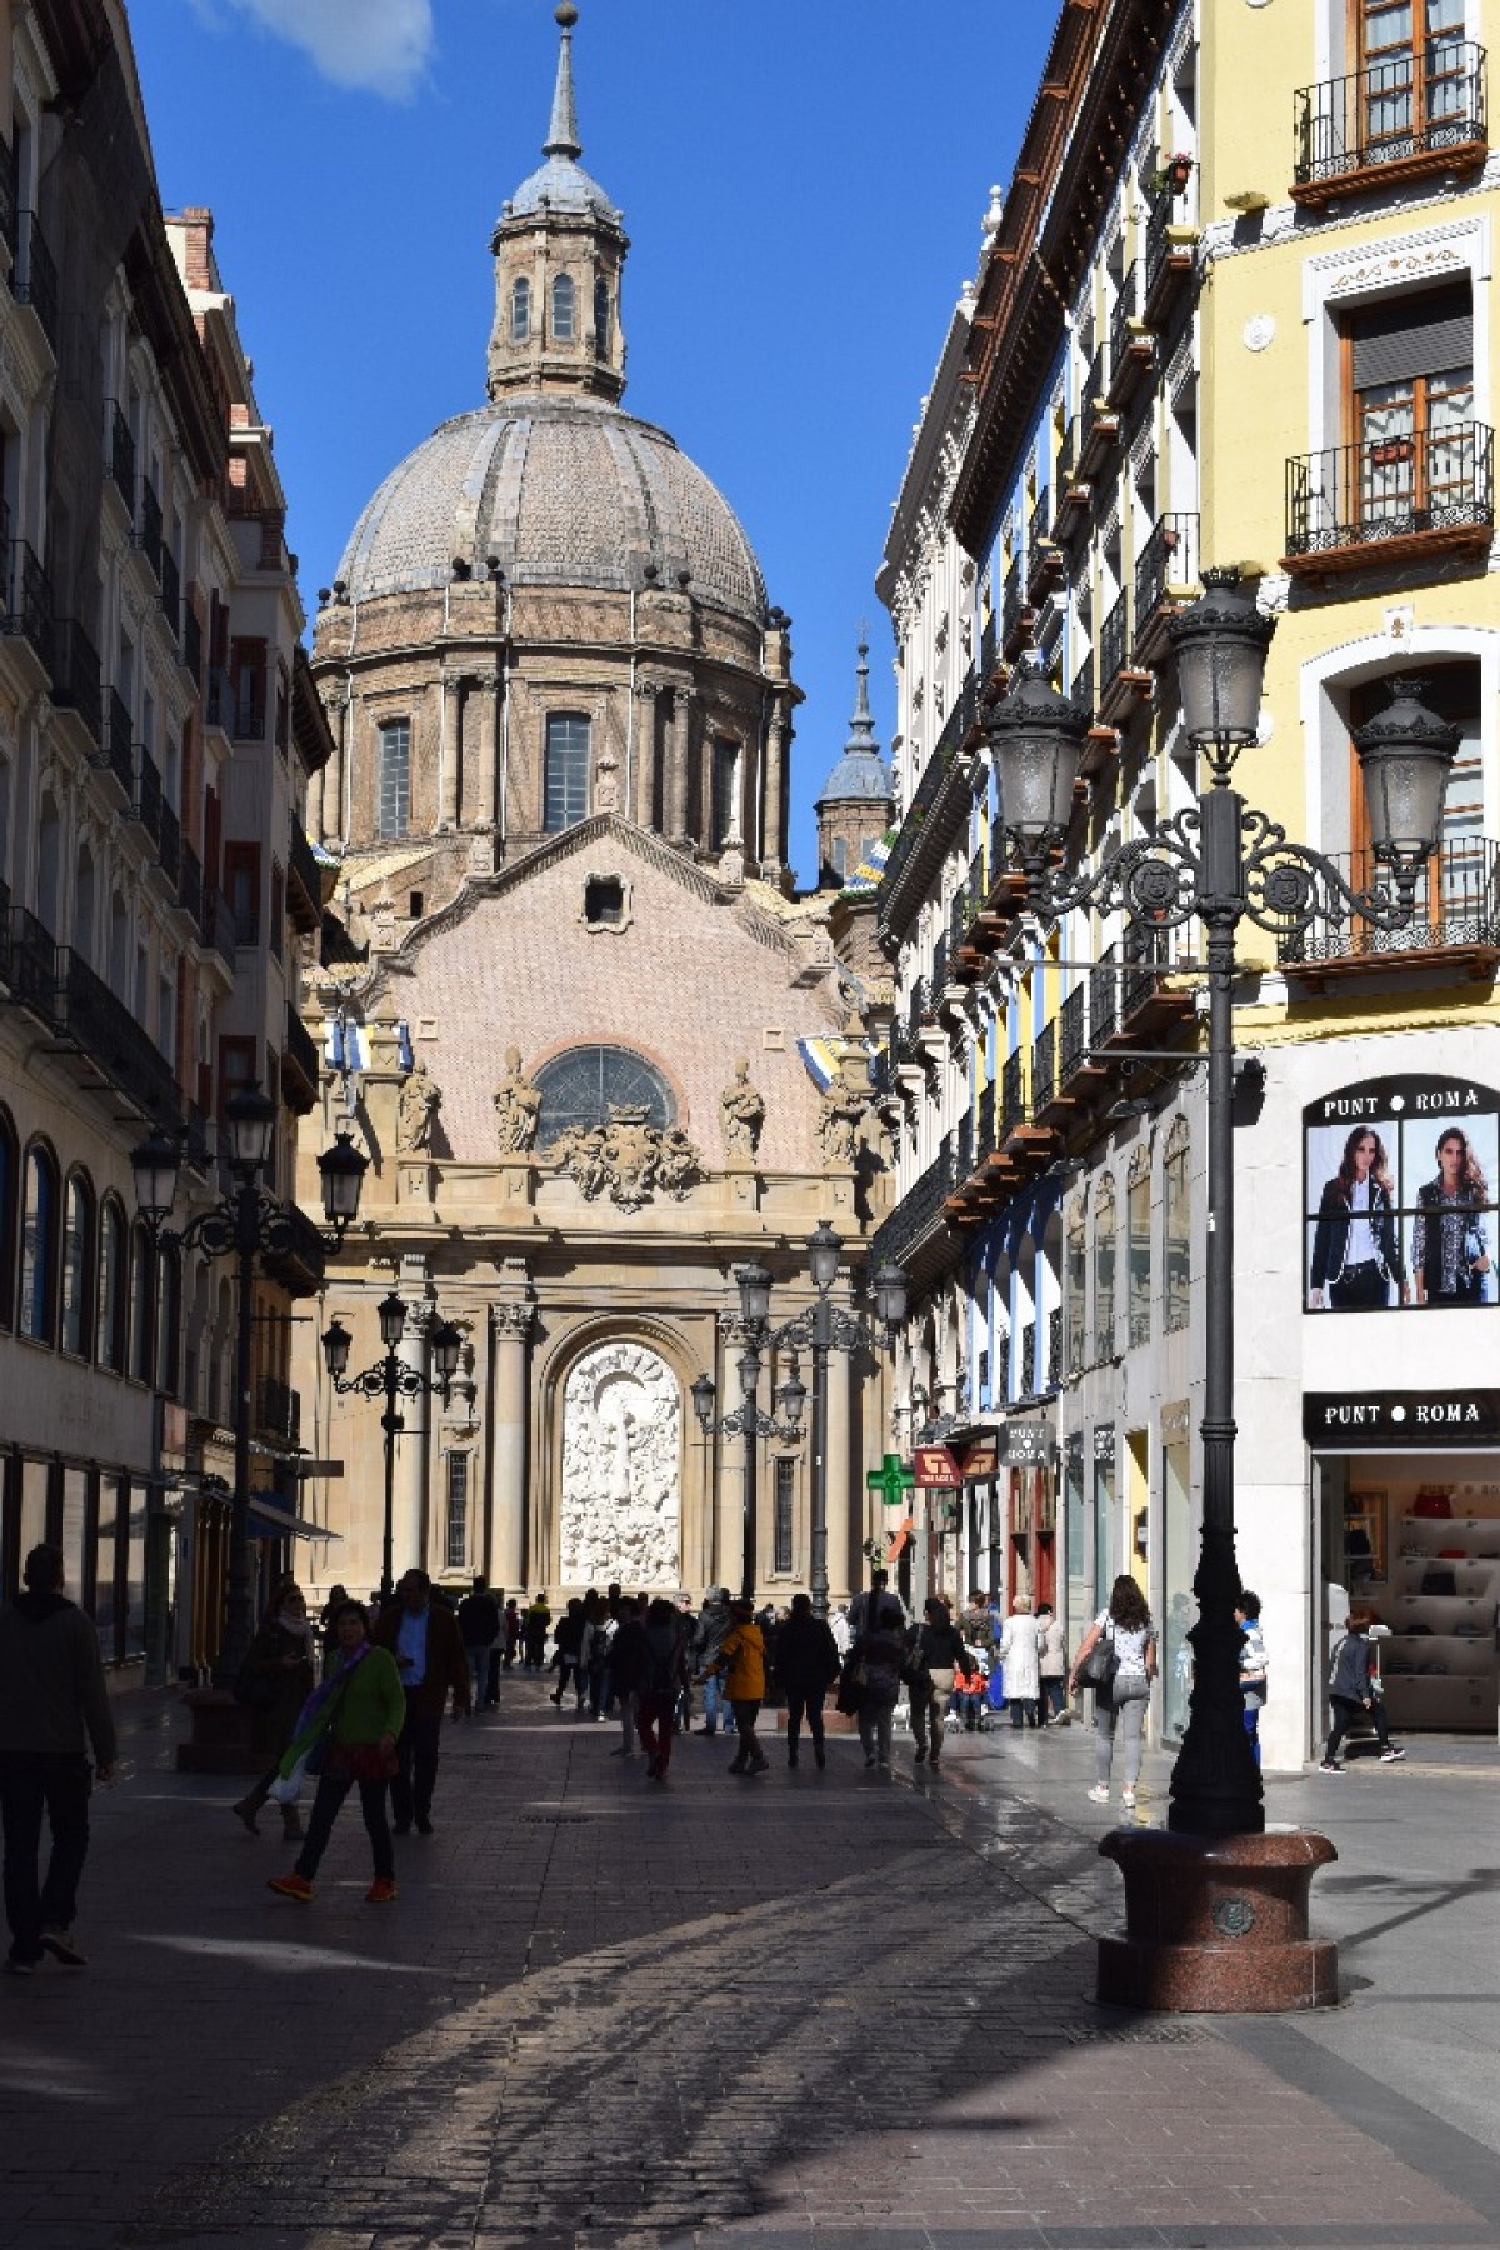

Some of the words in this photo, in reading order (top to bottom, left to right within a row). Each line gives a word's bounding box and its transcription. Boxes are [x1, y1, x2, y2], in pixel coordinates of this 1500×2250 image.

[1323, 1097, 1379, 1119] PUNT
[1415, 1089, 1479, 1111] ROMA
[1324, 1405, 1380, 1424] PUNT
[1415, 1403, 1480, 1424] ROMA
